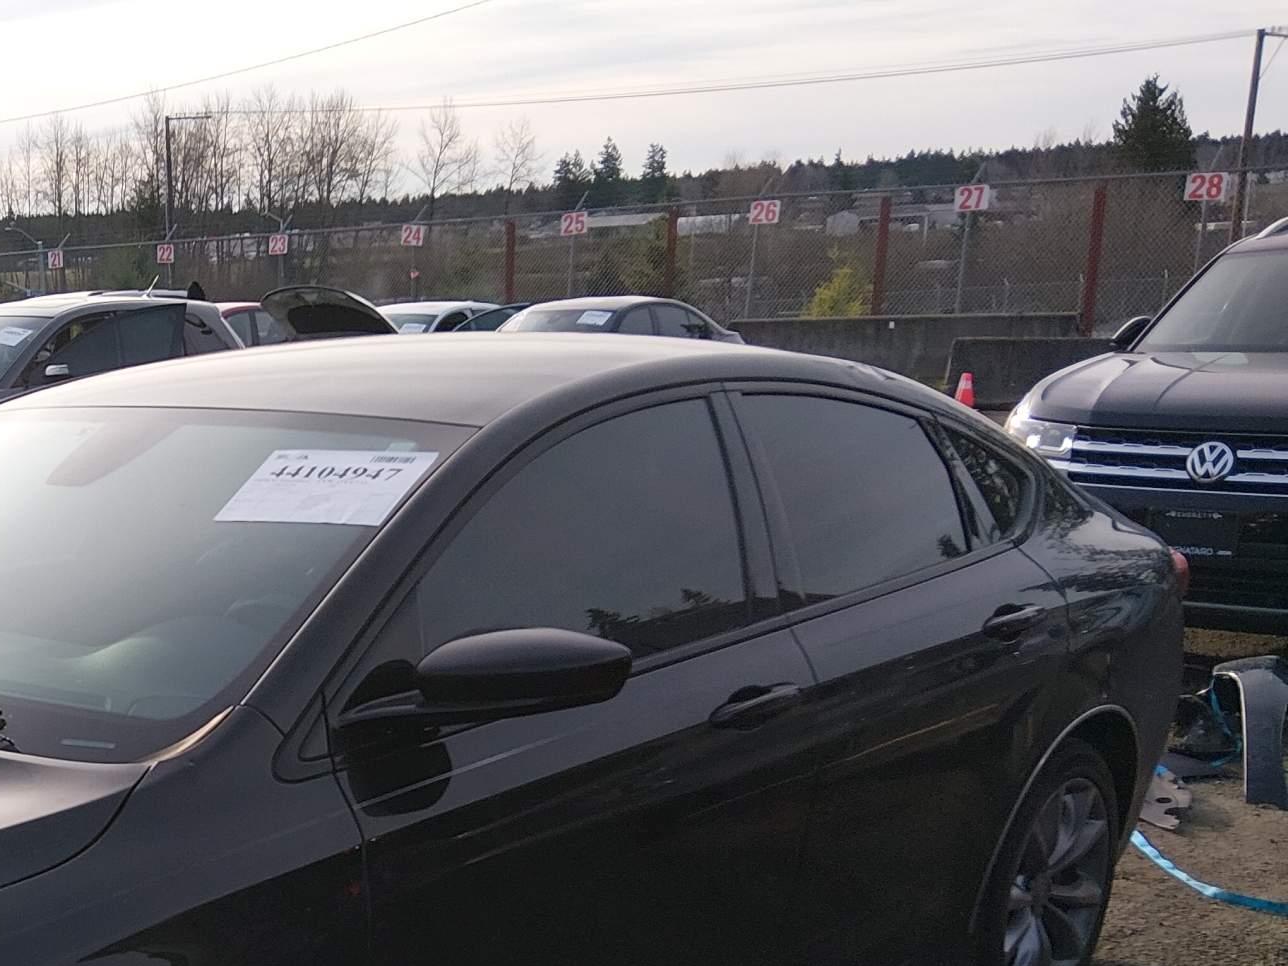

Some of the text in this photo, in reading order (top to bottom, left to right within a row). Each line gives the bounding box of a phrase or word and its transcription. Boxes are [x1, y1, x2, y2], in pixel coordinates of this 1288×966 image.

[1188, 174, 1224, 200] 28
[959, 186, 985, 210] 27
[752, 202, 777, 223] 26
[563, 214, 586, 234] 25
[270, 236, 286, 254] 23
[402, 225, 422, 245] 24
[49, 252, 62, 267] 21
[158, 246, 173, 262] 22
[1188, 442, 1232, 481] VW
[270, 464, 404, 482] 44104947
